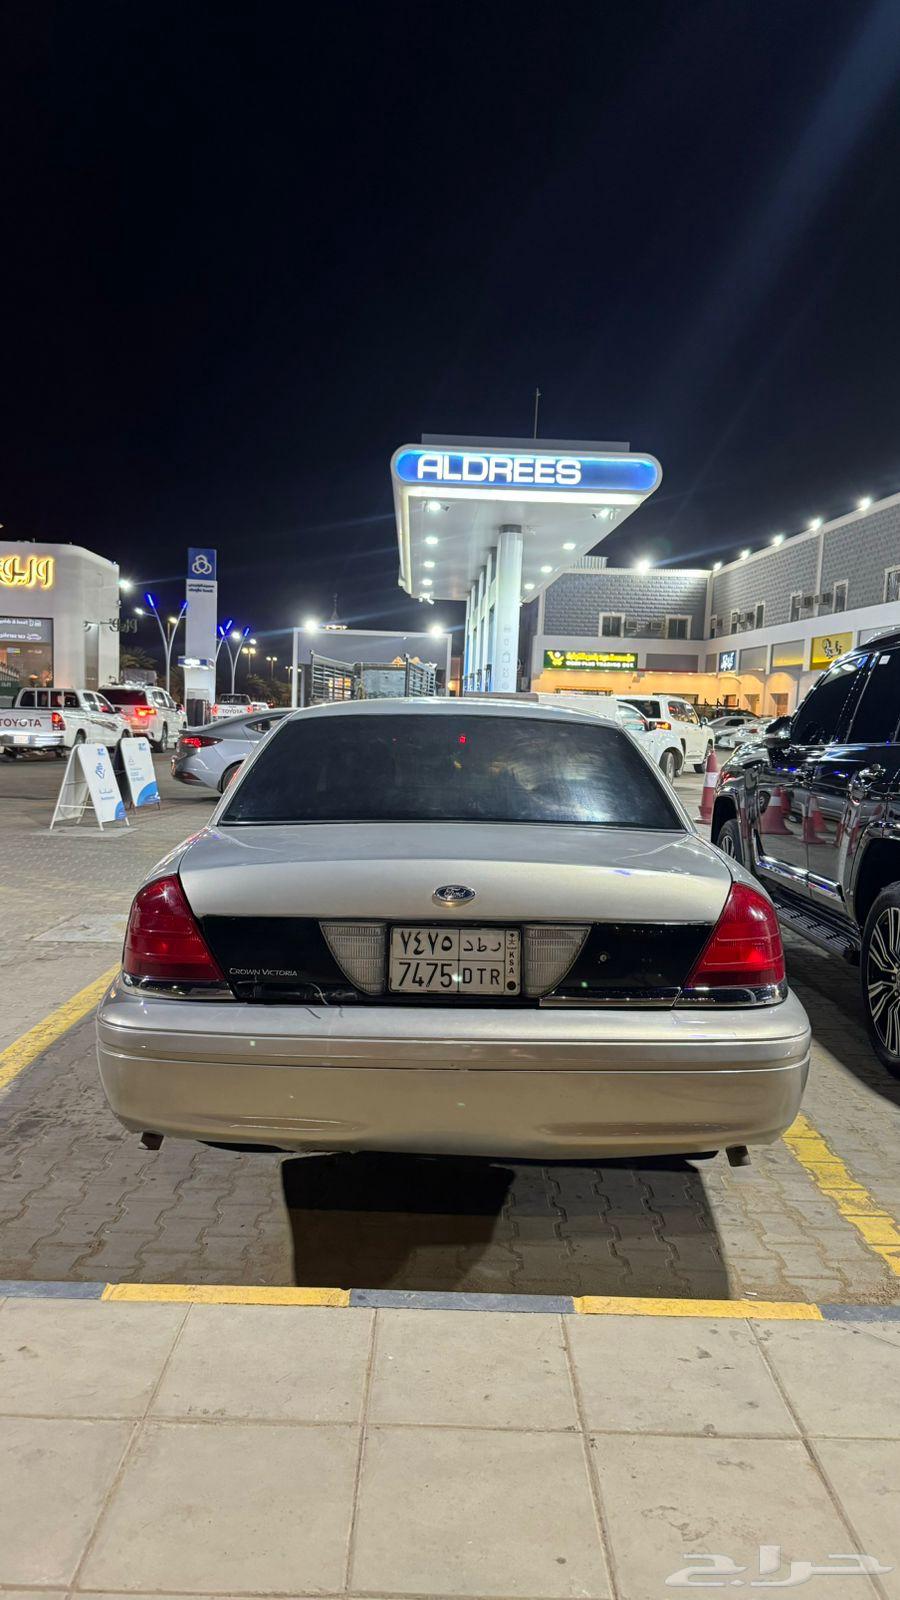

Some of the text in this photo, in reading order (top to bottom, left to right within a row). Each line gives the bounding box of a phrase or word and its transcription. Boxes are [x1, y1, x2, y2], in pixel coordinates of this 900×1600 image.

[417, 453, 582, 485] ALDREES
[444, 886, 466, 899] Ford
[400, 930, 454, 956] ٧٤٧٥
[229, 967, 298, 977] CROWN VICTORIA
[398, 961, 501, 988] 7475 DTR
